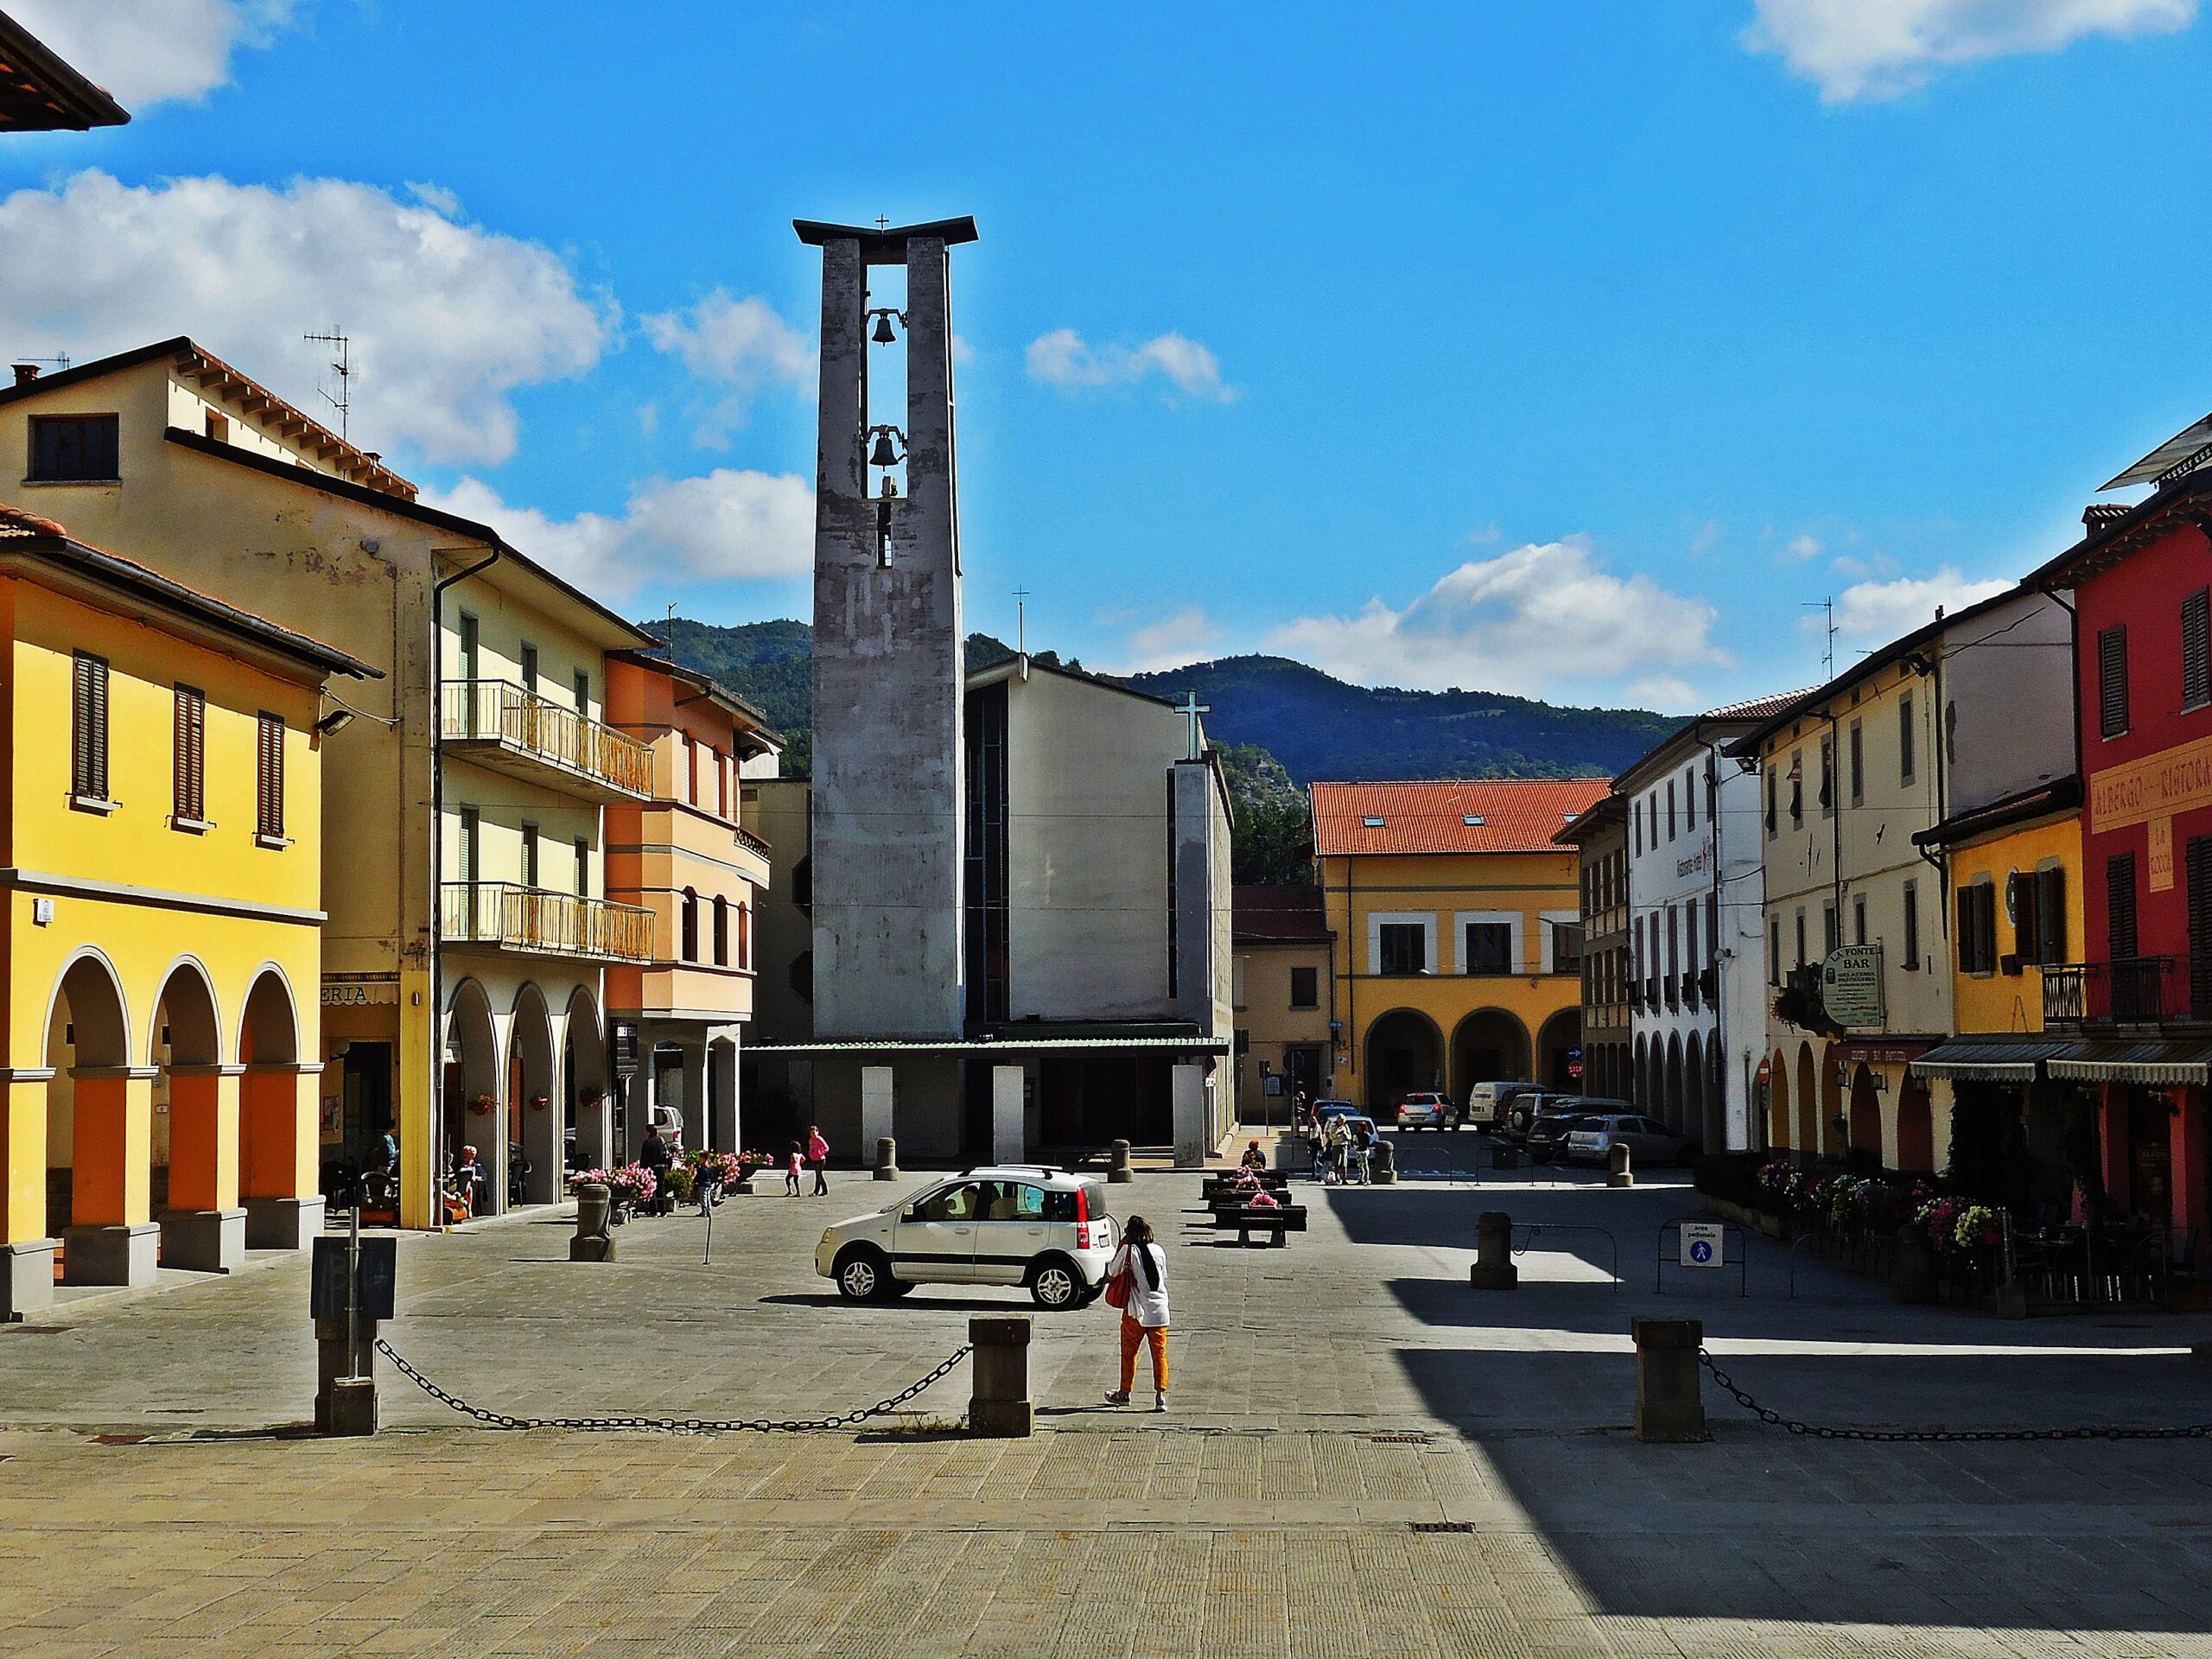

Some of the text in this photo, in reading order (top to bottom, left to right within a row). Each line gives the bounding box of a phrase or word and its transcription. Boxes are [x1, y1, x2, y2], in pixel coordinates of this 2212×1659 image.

[1830, 947, 1876, 963] LA FONTE
[1844, 958, 1870, 969] BAR
